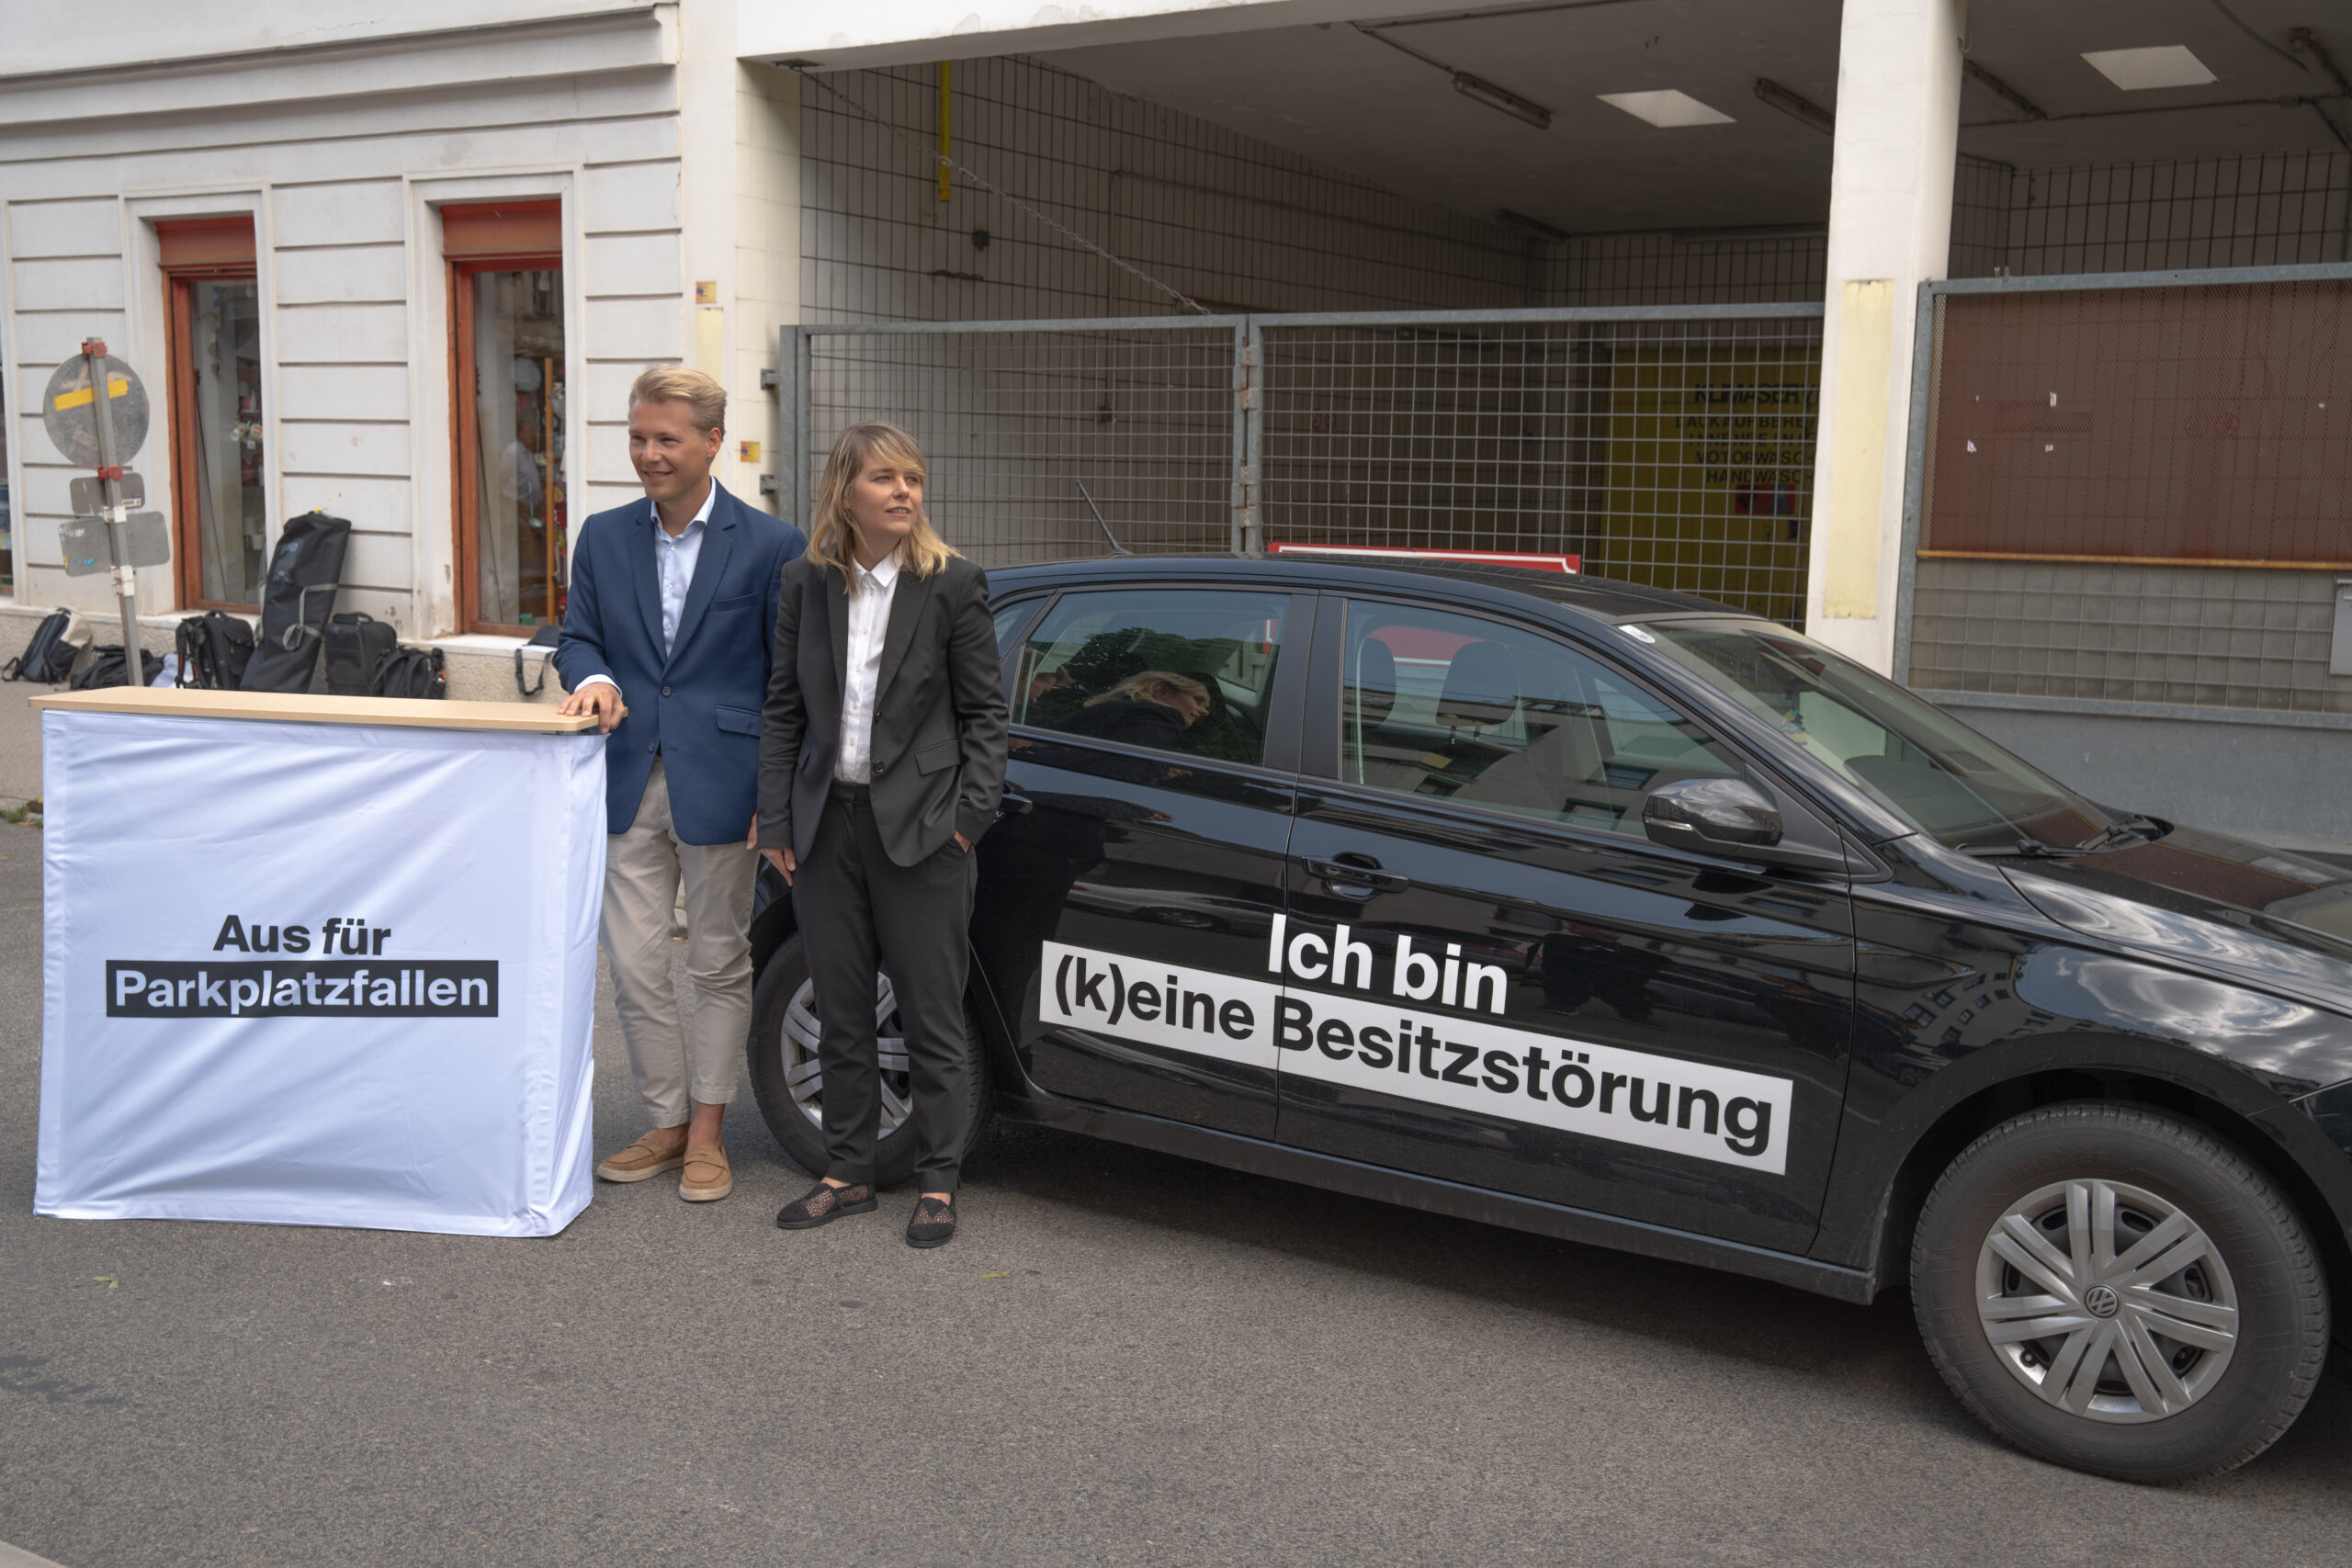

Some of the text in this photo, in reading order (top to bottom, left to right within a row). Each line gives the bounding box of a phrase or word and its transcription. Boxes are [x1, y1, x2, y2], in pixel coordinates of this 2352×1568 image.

[213, 914, 391, 956] Aus für
[1268, 912, 1508, 1015] Ich bin
[116, 969, 489, 1015] Parkplatzfallen
[1055, 953, 1772, 1157] (k)eine Besitzstörung
